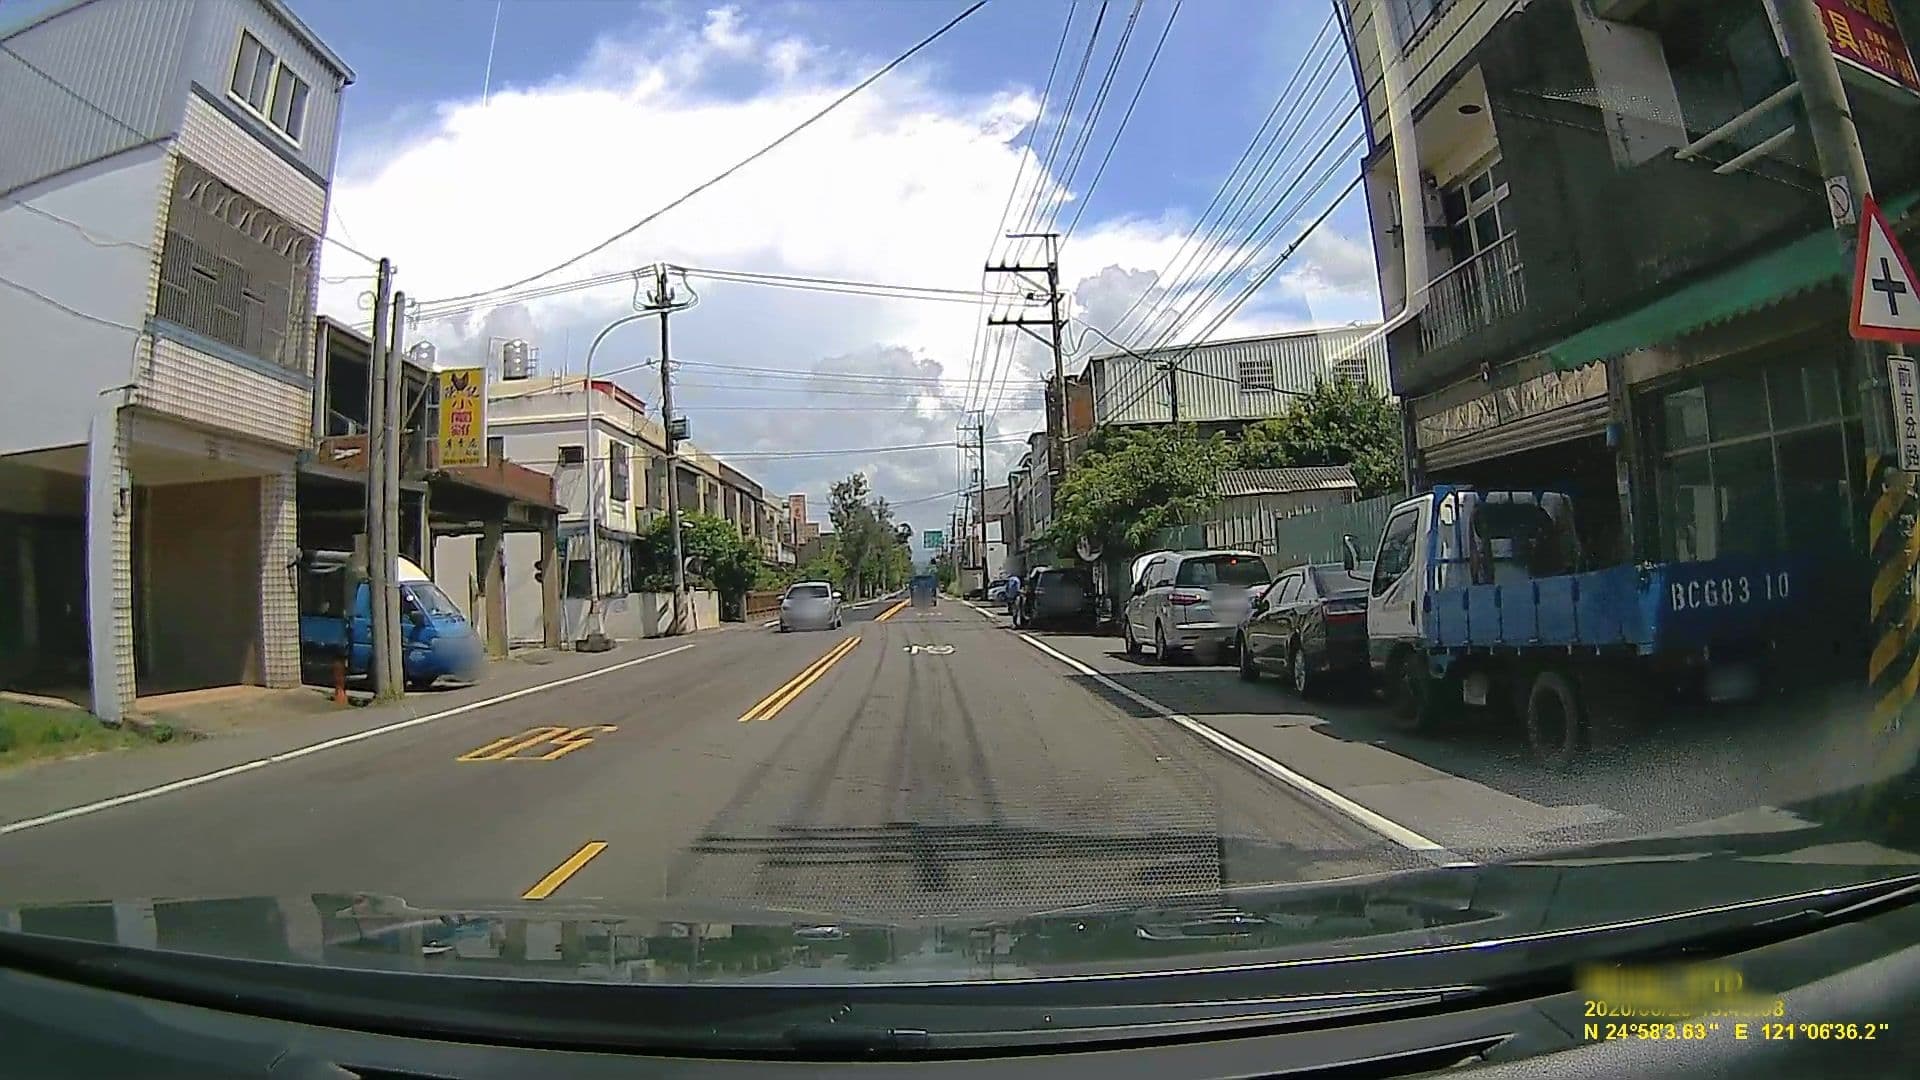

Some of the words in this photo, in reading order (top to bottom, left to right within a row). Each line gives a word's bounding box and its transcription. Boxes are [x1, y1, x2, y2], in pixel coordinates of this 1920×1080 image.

[1822, 9, 1862, 57] 具
[1897, 364, 1920, 469] 前有岔路
